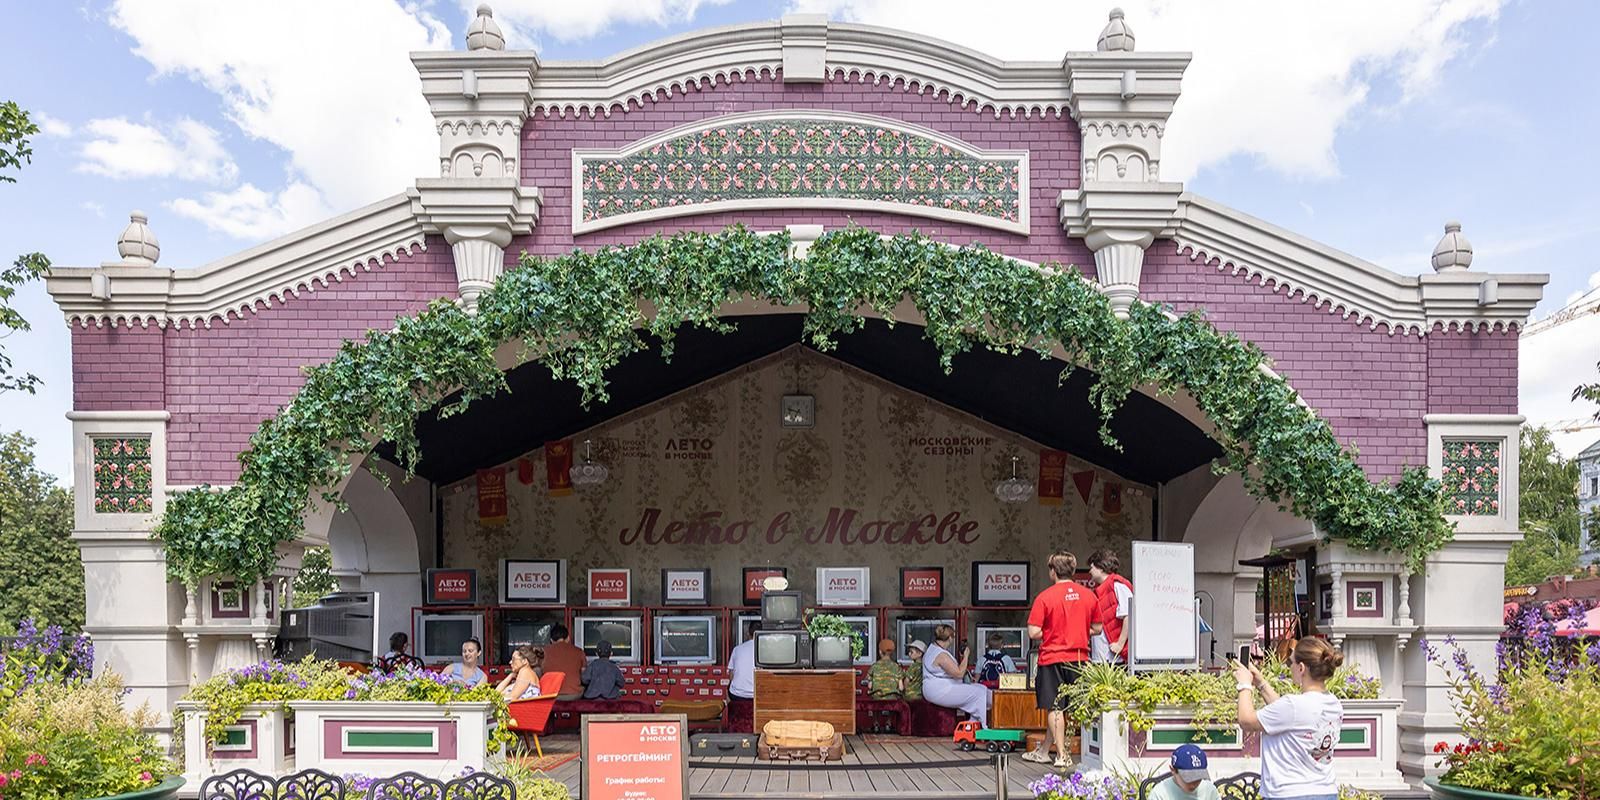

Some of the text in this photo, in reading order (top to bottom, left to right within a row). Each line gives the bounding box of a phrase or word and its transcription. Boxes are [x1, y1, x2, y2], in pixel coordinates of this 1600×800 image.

[665, 439, 713, 451] ЛЕТО
[908, 437, 992, 446] МОСКОВСКИЕ
[924, 447, 974, 456] СЕЗОНЫ
[619, 507, 980, 546] Лето в Москве
[514, 572, 551, 582] ЛЕТО
[829, 578, 857, 586] ЛЕТО
[985, 574, 1021, 584] ЛЕТО
[439, 579, 466, 587] ЛЕТО
[640, 725, 677, 735] ЛЕТО
[597, 752, 673, 762] РЕТРОГЕЙМИНГ
[605, 777, 666, 785] График работы:
